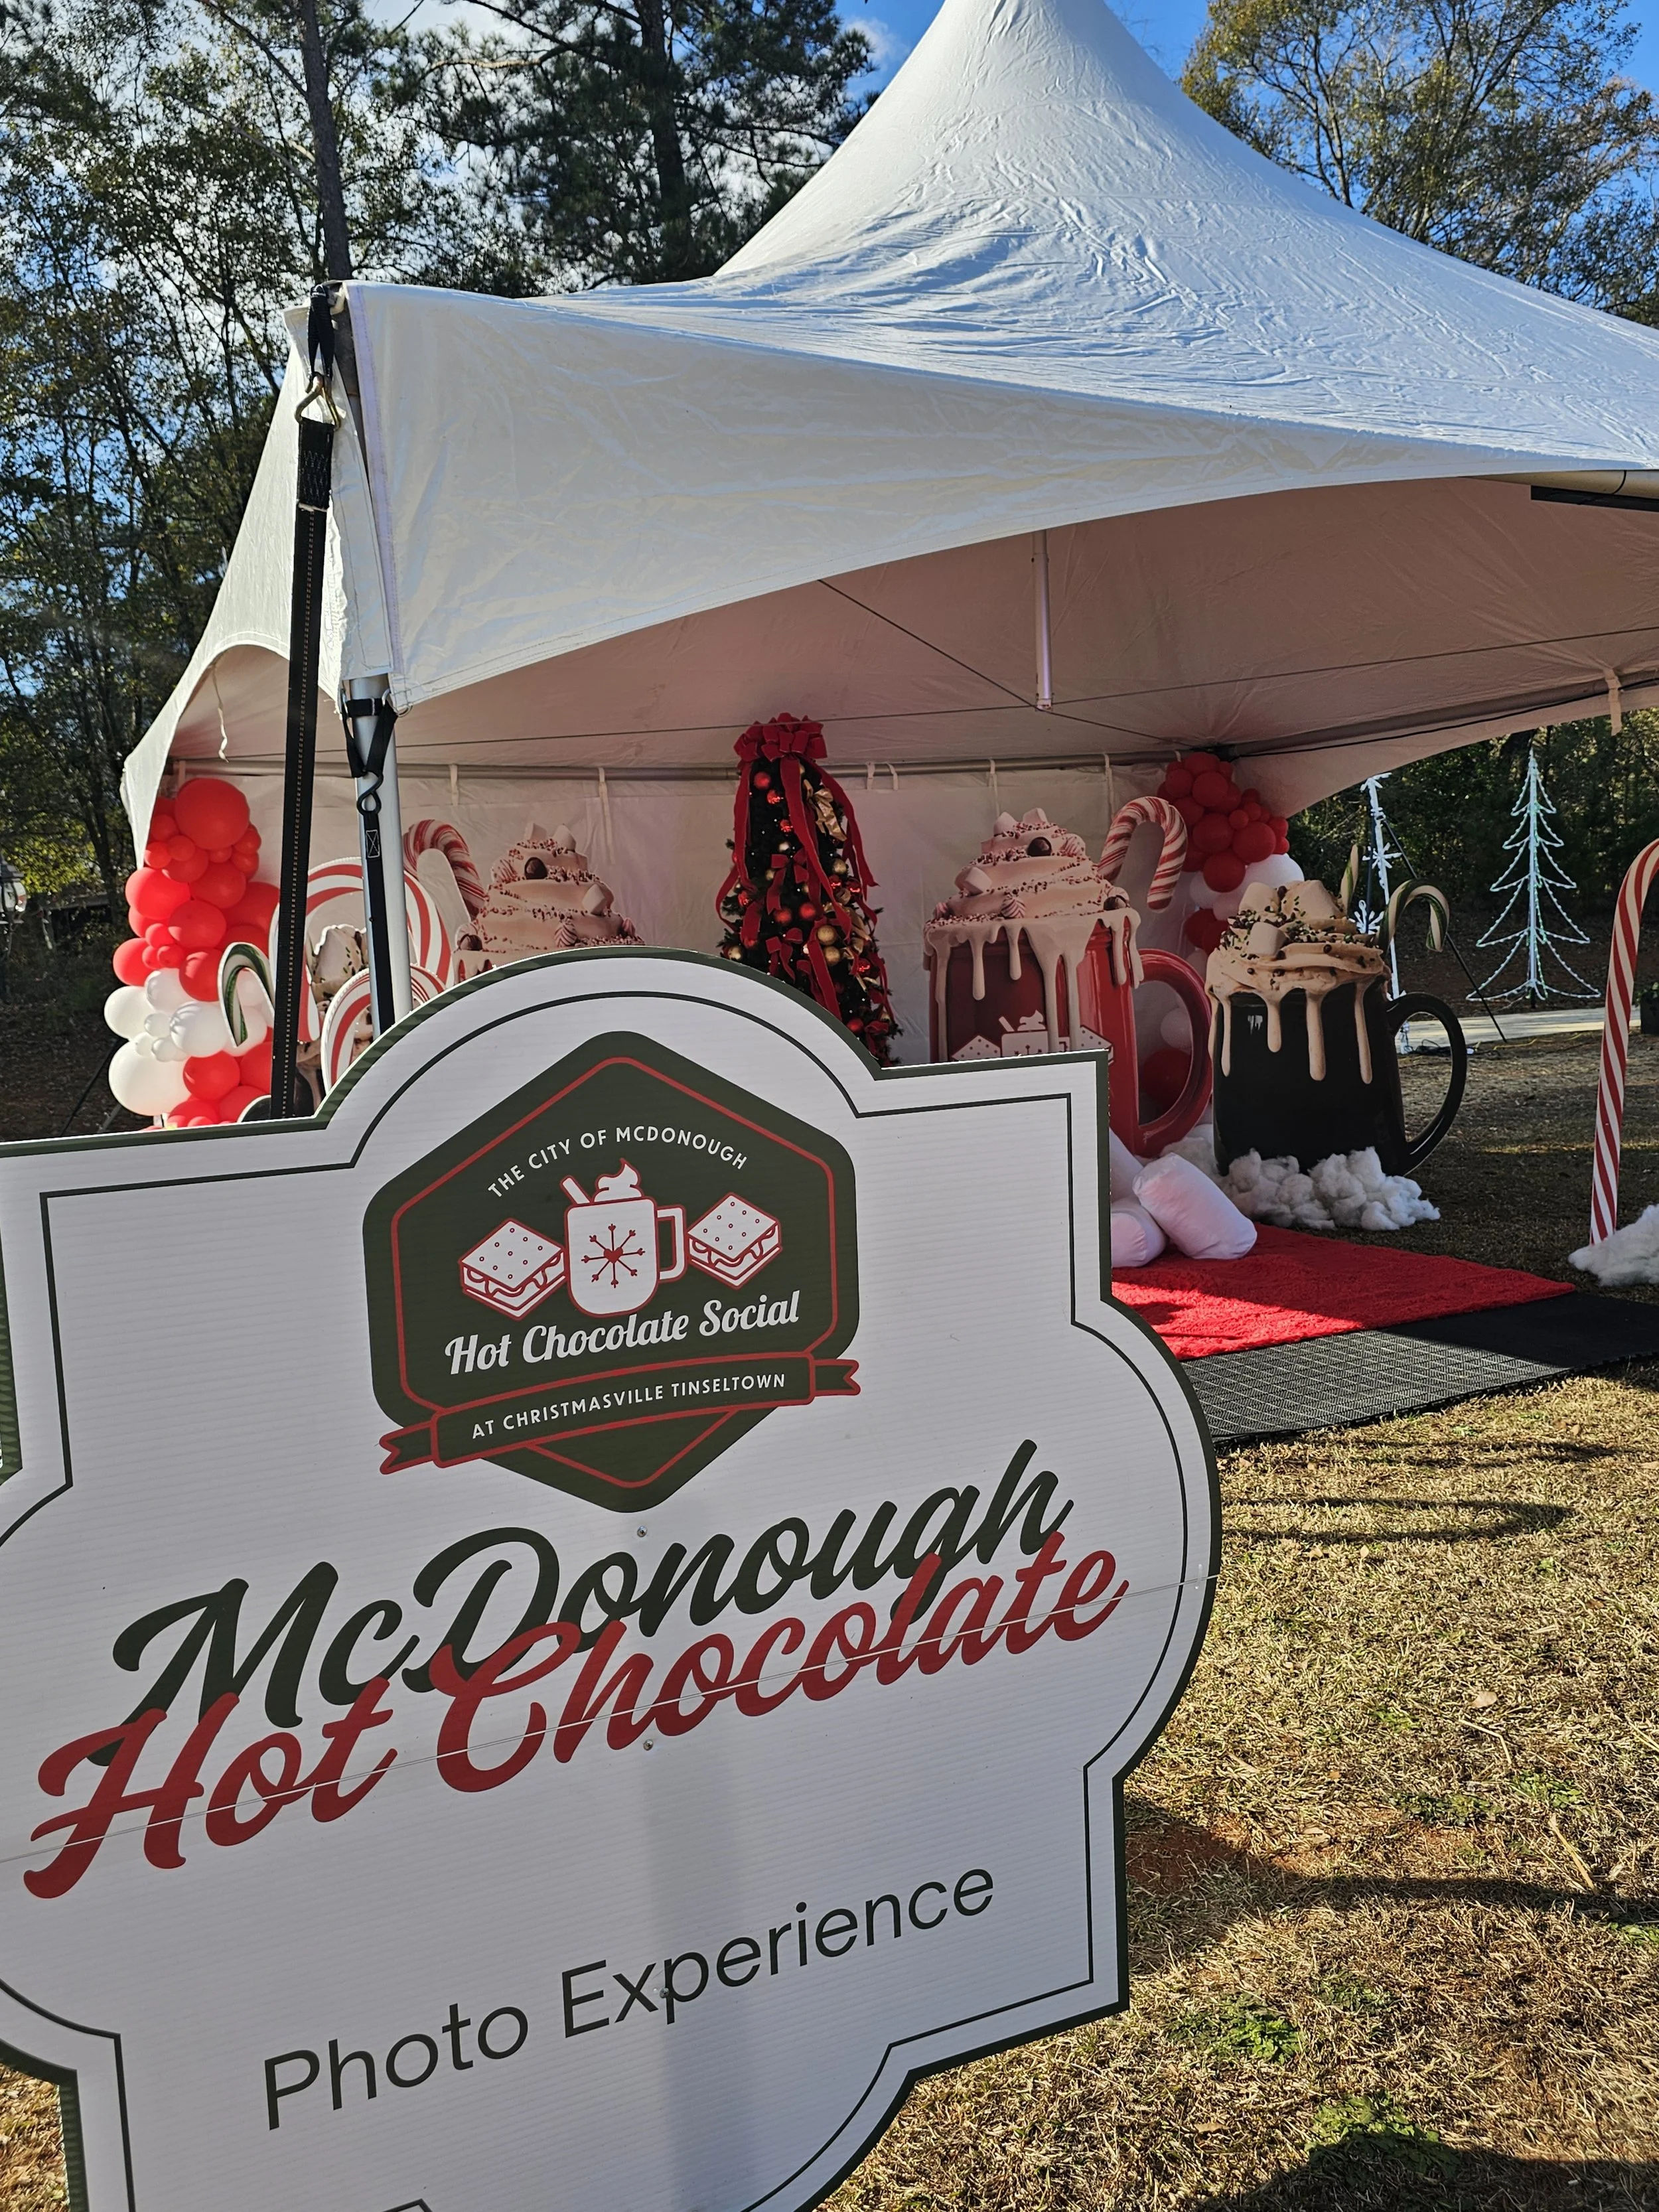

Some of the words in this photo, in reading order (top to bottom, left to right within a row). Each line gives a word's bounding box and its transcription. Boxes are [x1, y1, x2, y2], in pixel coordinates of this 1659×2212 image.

[488, 1165, 526, 1198] THE
[528, 1140, 571, 1169] CITY
[580, 1130, 607, 1149] OF
[616, 1126, 748, 1169] MCDONOUGH
[445, 1335, 512, 1375] Hot
[522, 1310, 689, 1363] Chocolate
[699, 1290, 801, 1337] Social
[472, 1420, 494, 1439] AT
[502, 1385, 664, 1431] CHRISTMASVILLE
[671, 1374, 786, 1398] TINSELTOWN
[113, 1439, 1074, 1767] McDonough
[23, 1676, 398, 1899] Hot
[429, 1531, 1129, 1793] Chocolate
[263, 2003, 529, 2131] Photo
[561, 1868, 994, 2039] Experience
